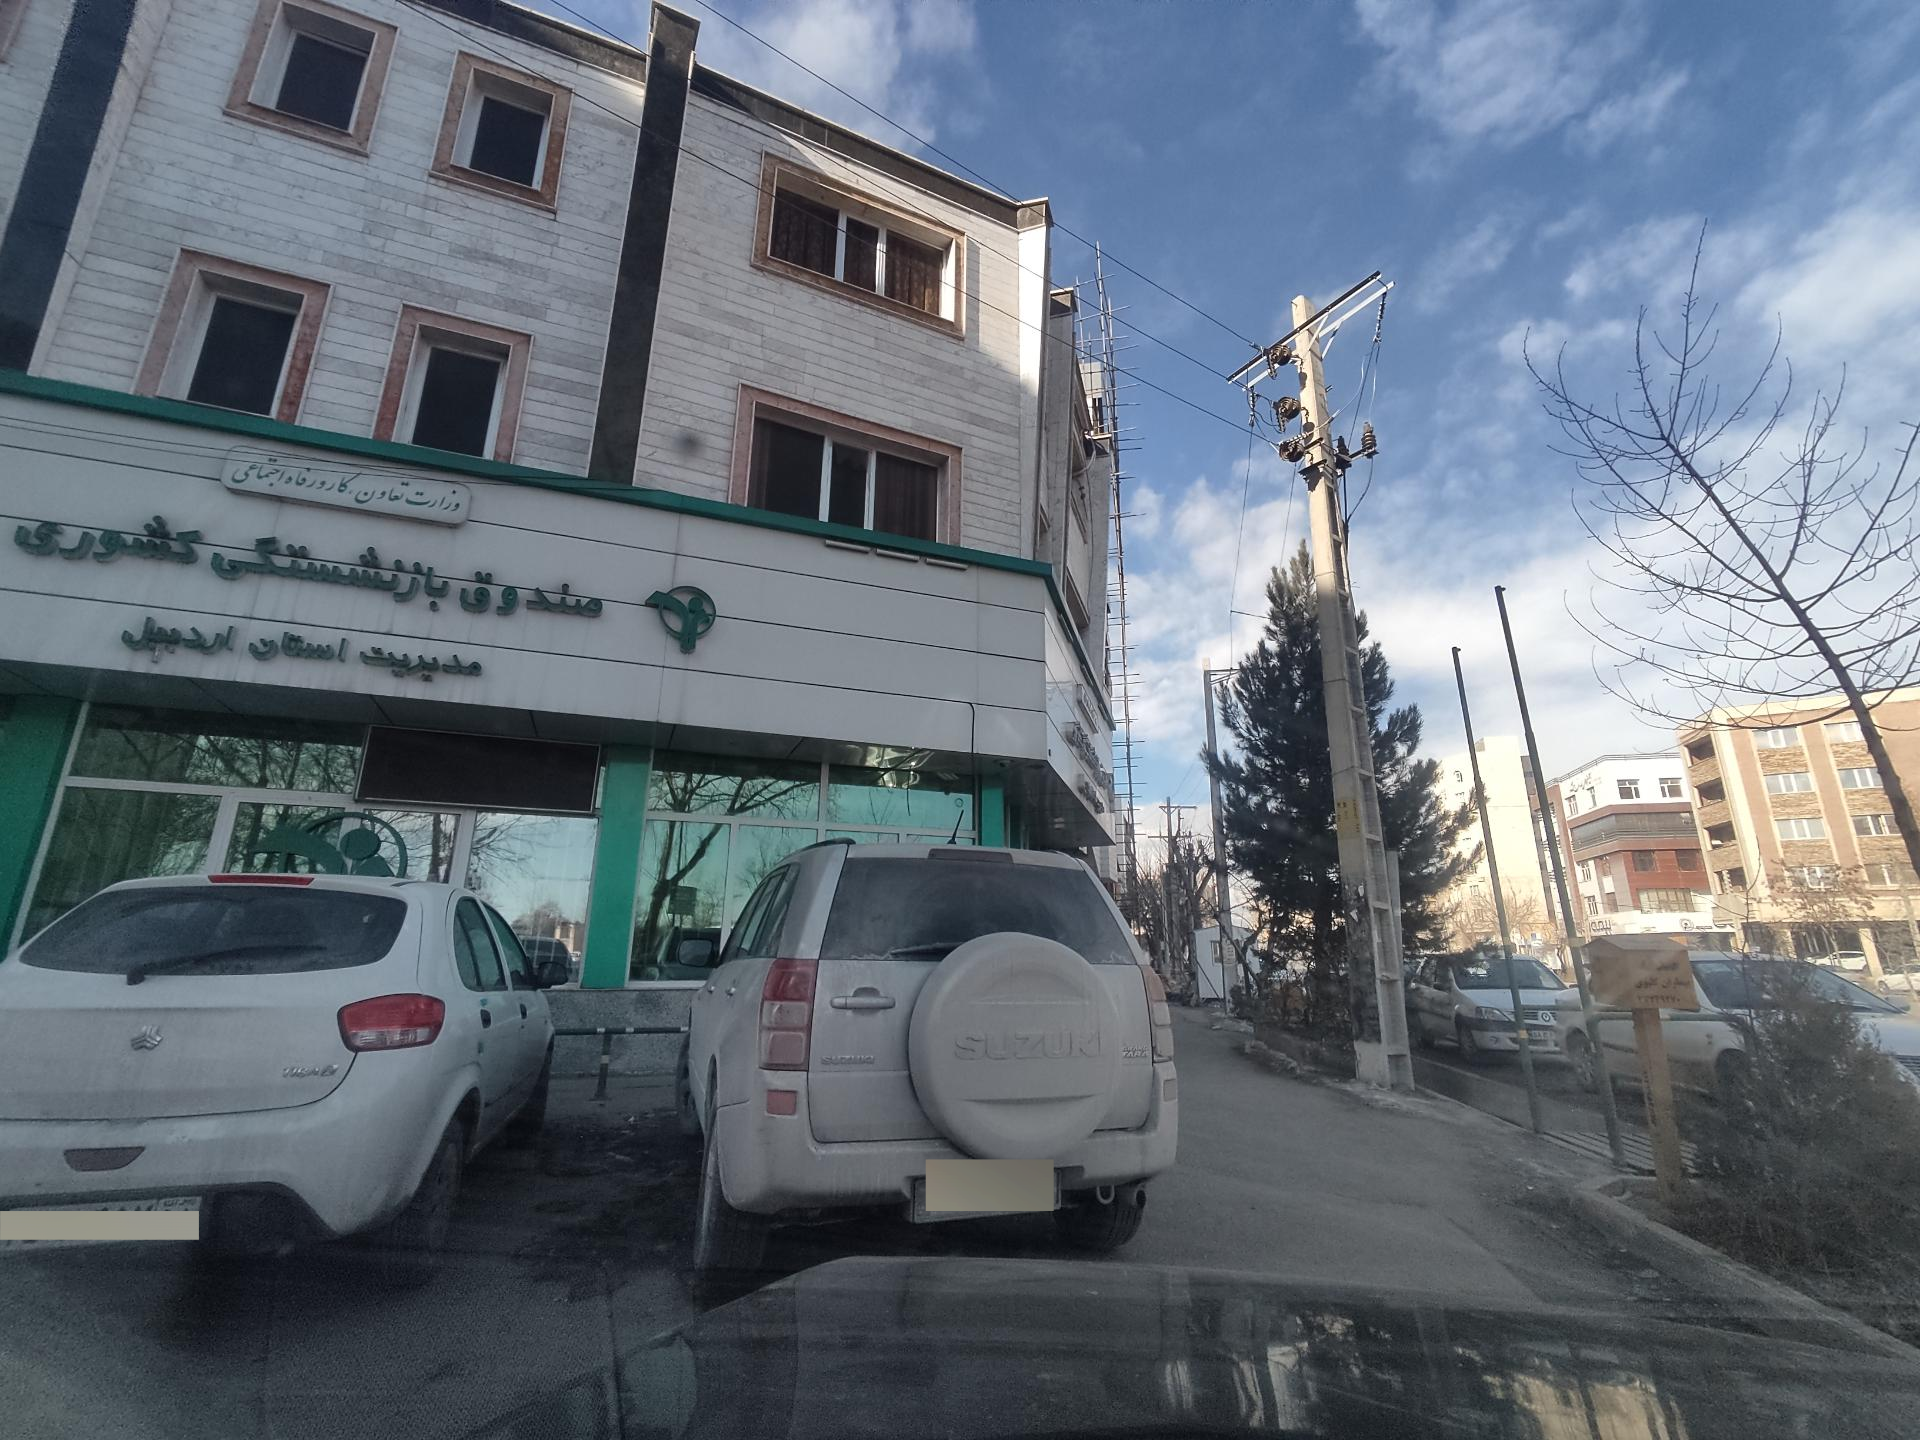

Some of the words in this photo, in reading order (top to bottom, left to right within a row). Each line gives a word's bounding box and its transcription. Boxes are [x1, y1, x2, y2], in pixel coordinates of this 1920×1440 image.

[231, 458, 285, 487] اجتماعی
[405, 488, 461, 512] وزارت
[14, 515, 202, 564] کشوری
[210, 536, 449, 612] بازنشستگی
[459, 570, 603, 617] صندوق
[121, 616, 234, 664] اردبیل
[248, 631, 349, 664] استان
[360, 646, 482, 682] مدیریت
[820, 1055, 875, 1065] SUZUKI
[954, 1031, 1102, 1061] SUZUKI
